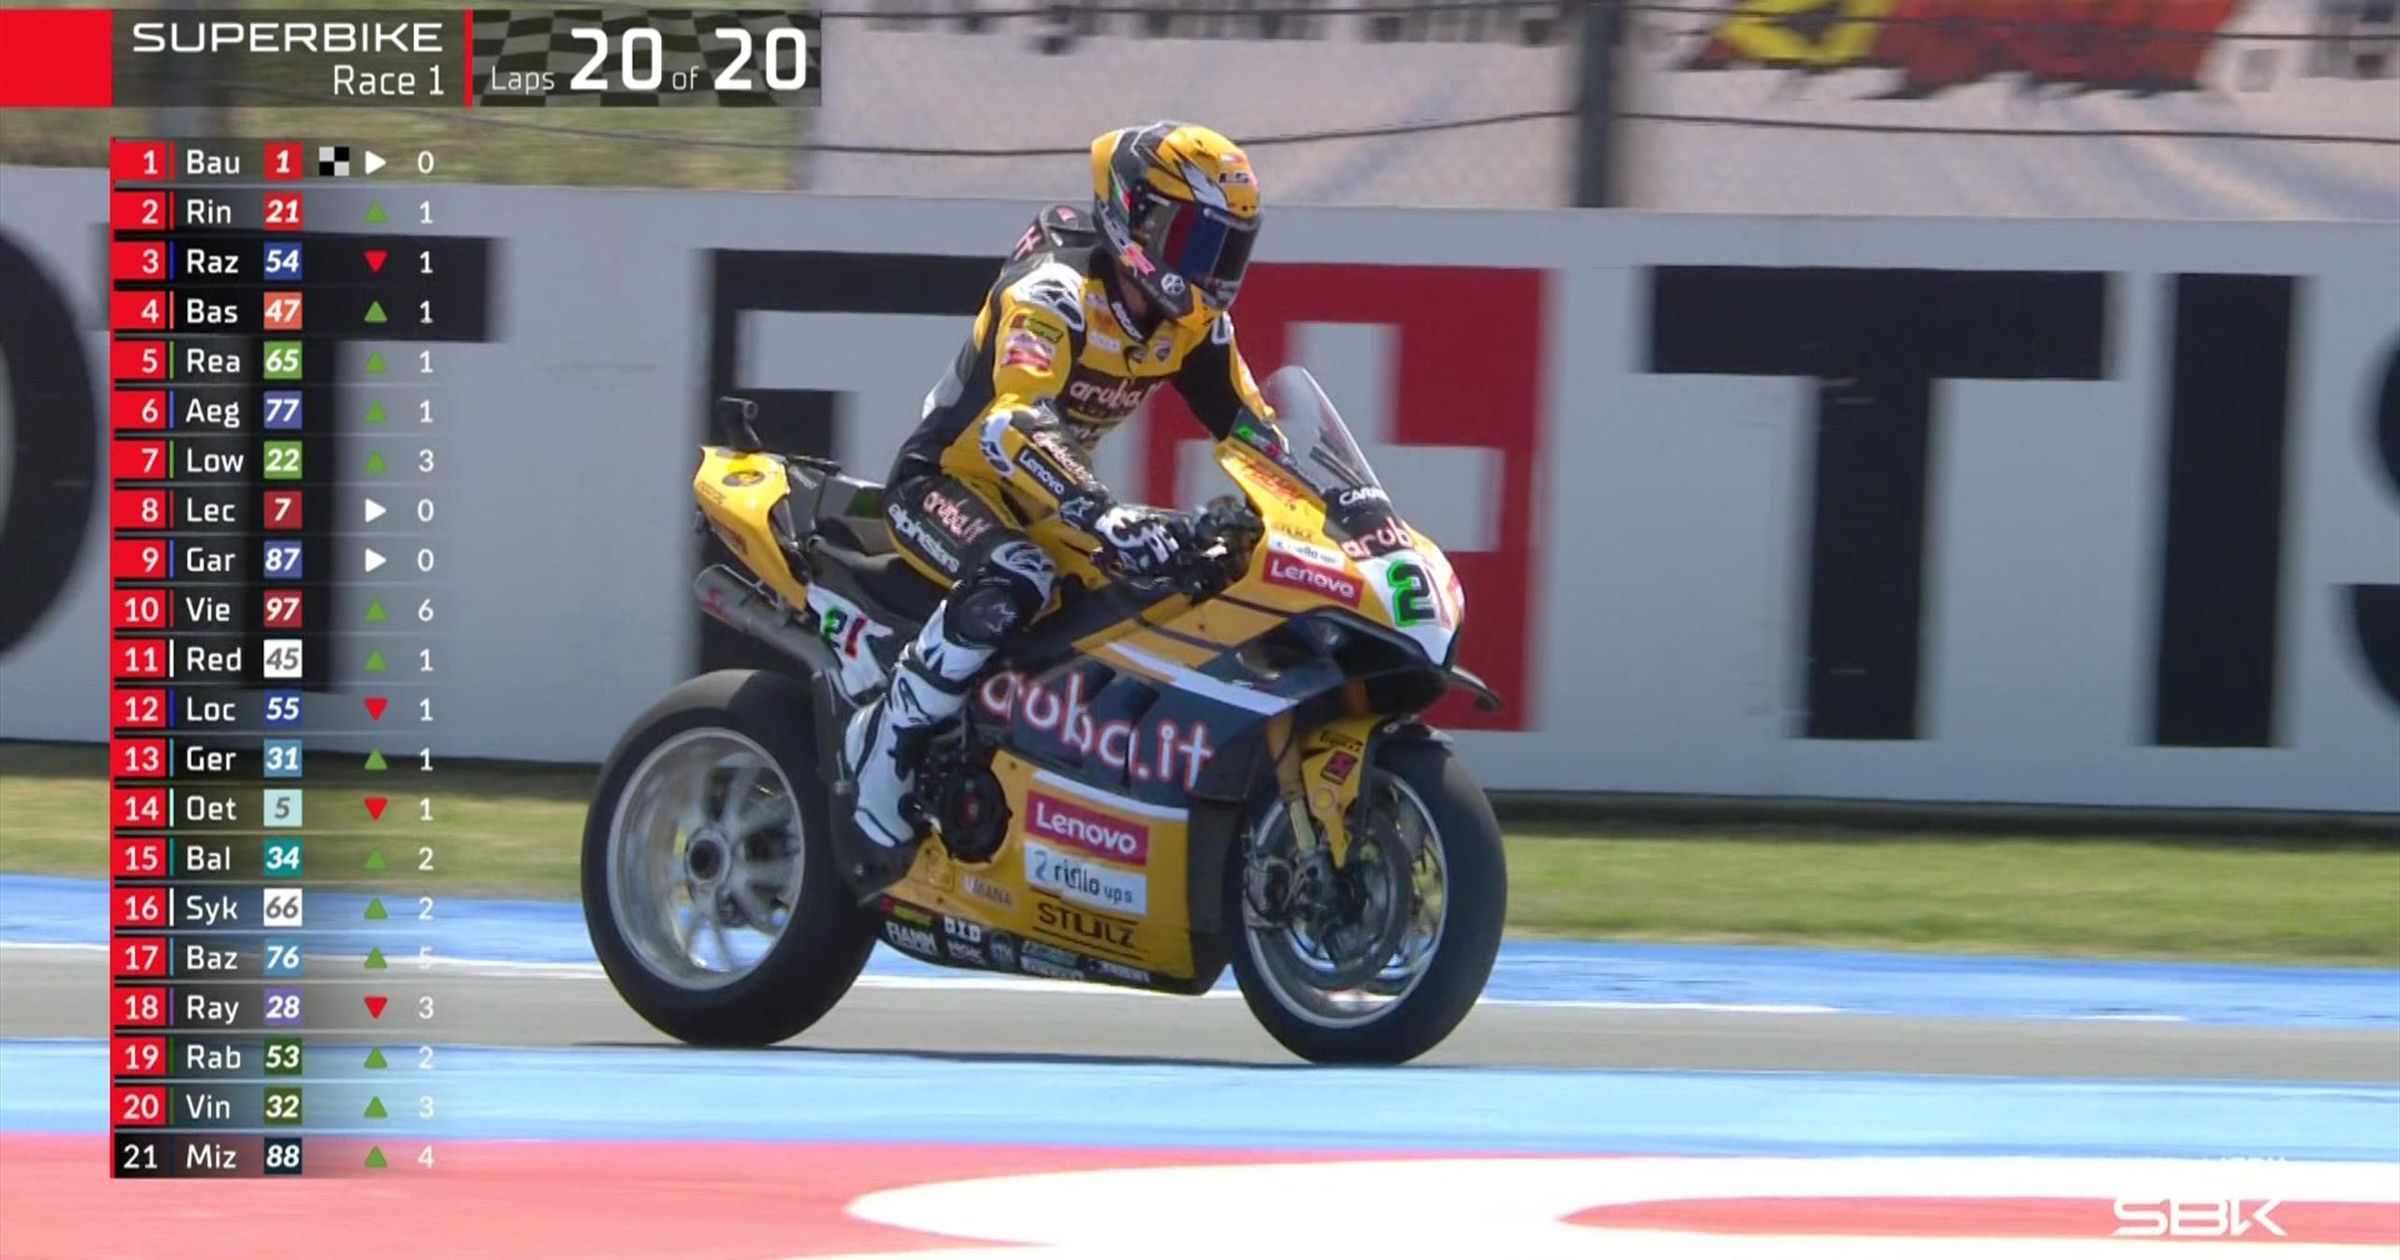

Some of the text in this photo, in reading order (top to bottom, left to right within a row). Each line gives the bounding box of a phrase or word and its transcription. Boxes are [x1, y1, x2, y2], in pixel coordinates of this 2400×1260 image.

[1020, 449, 1065, 495] Lenovo
[1638, 263, 2400, 748] TI
[1270, 559, 1355, 598] Lenovo
[1036, 801, 1137, 854] Lenovo
[1104, 885, 1133, 904] ups
[1037, 901, 1136, 948] STULZ
